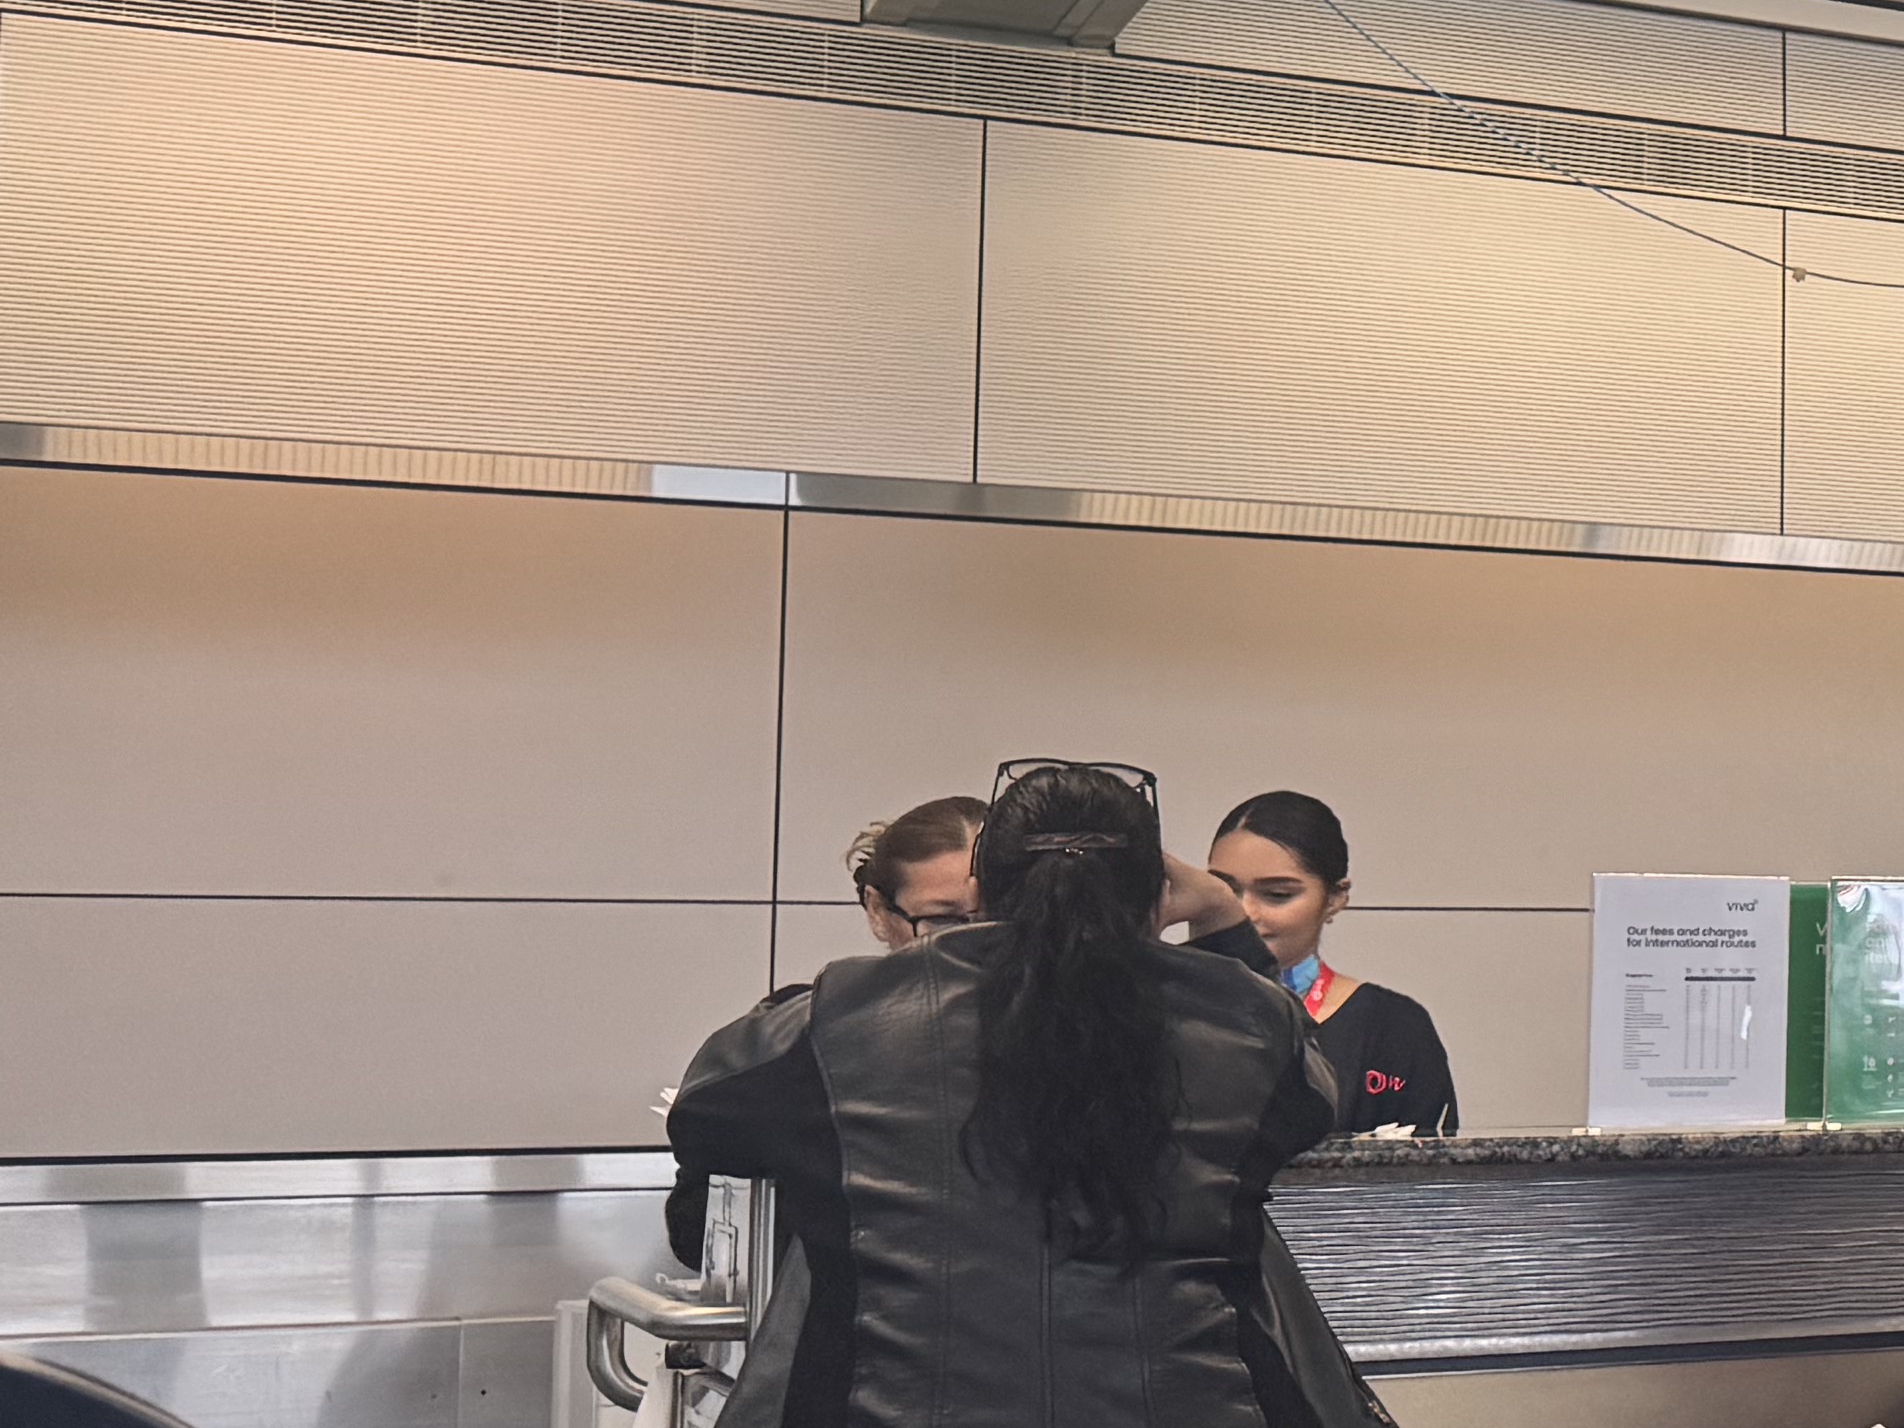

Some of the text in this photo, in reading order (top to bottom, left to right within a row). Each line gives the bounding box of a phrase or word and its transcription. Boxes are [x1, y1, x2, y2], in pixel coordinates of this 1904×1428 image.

[1627, 926, 1748, 939] Our fees and charges
[1626, 937, 1642, 948] for
[1720, 938, 1756, 948] routes
